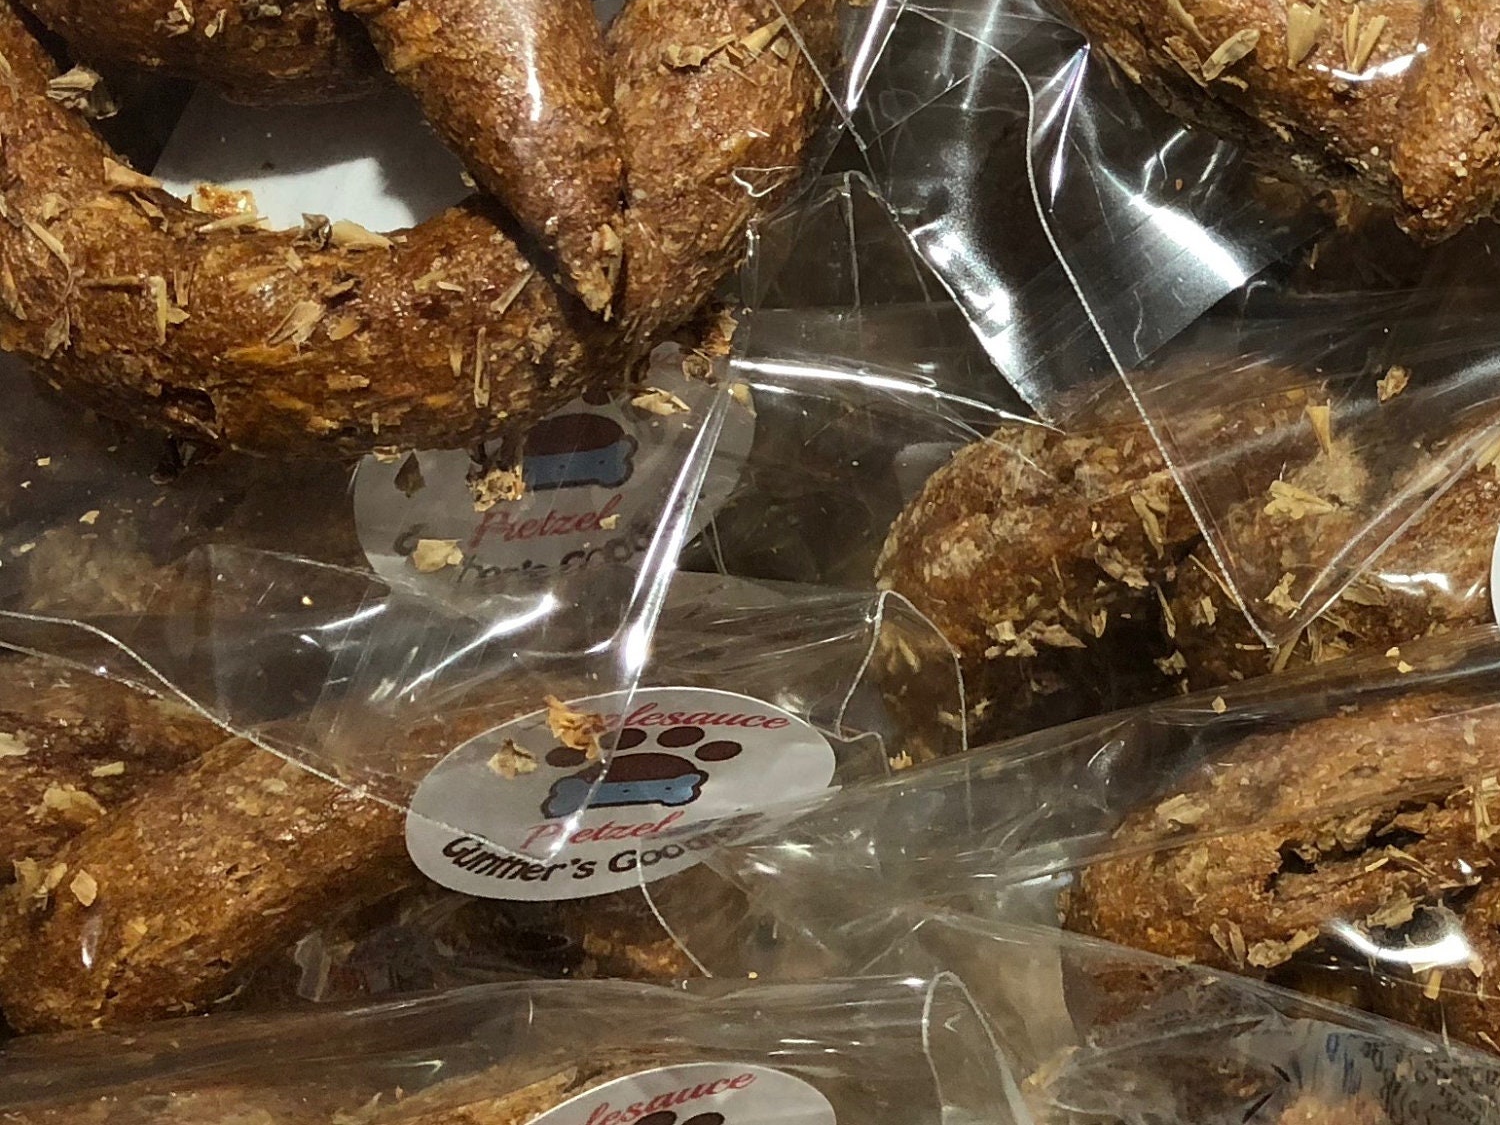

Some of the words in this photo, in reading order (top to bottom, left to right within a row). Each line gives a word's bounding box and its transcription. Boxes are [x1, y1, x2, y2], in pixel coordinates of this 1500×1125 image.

[469, 493, 624, 550] Pretzel
[519, 810, 685, 850] Petzel
[585, 1072, 757, 1125] lesauce
